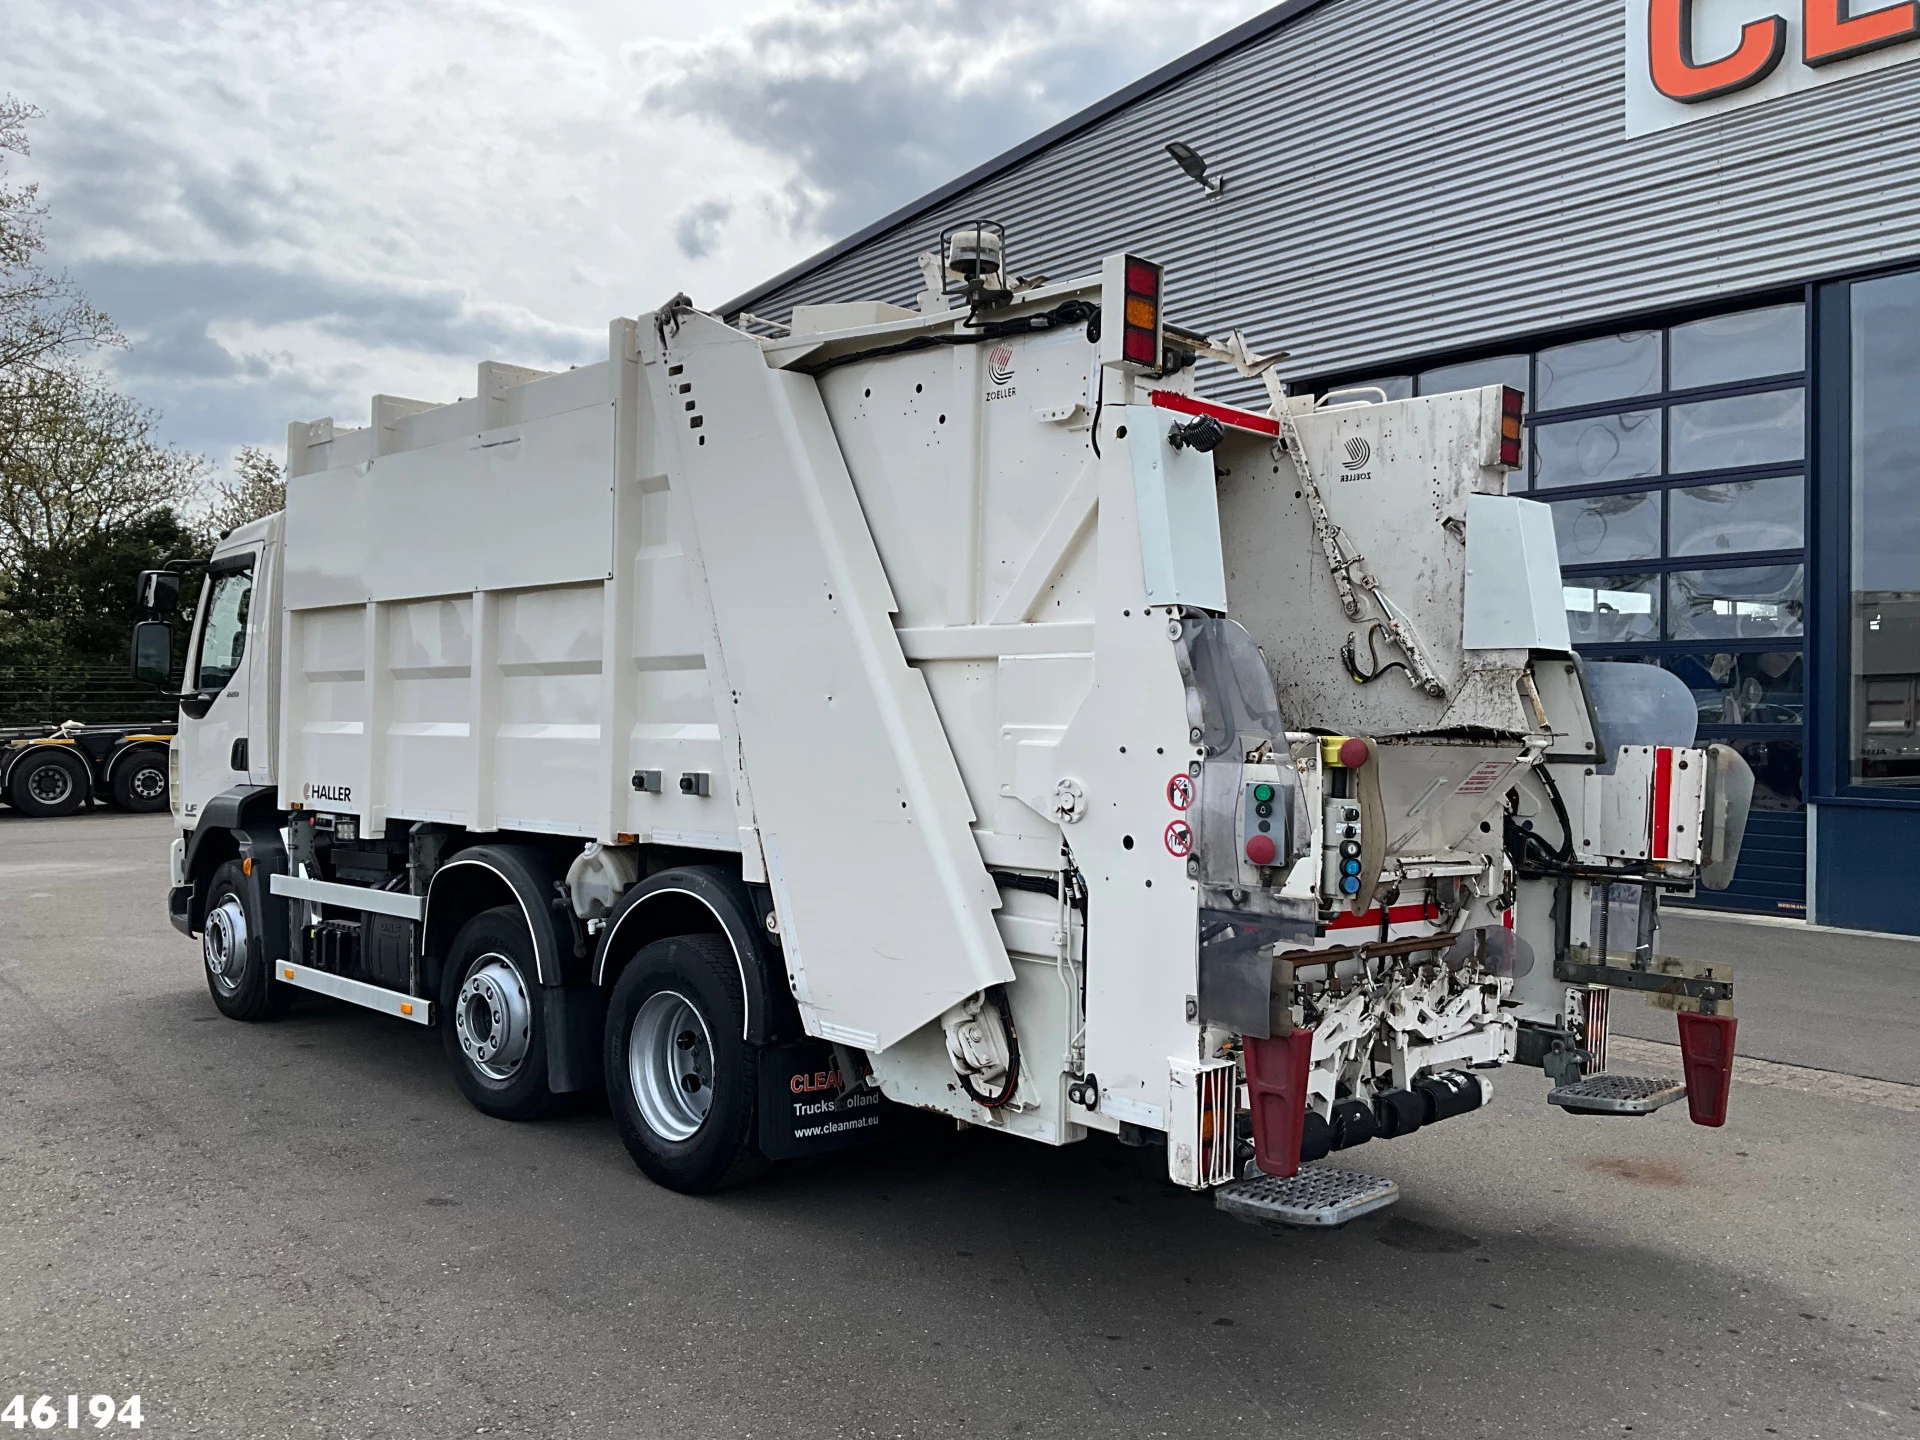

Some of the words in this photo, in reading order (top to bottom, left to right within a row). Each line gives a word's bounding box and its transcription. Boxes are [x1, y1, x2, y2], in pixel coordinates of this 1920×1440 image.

[985, 387, 1017, 402] ZOELLER
[311, 784, 352, 802] HALLER
[793, 1099, 835, 1117] Trucks
[845, 1091, 879, 1108] olland
[794, 1115, 879, 1138] www.cleanmat.eu
